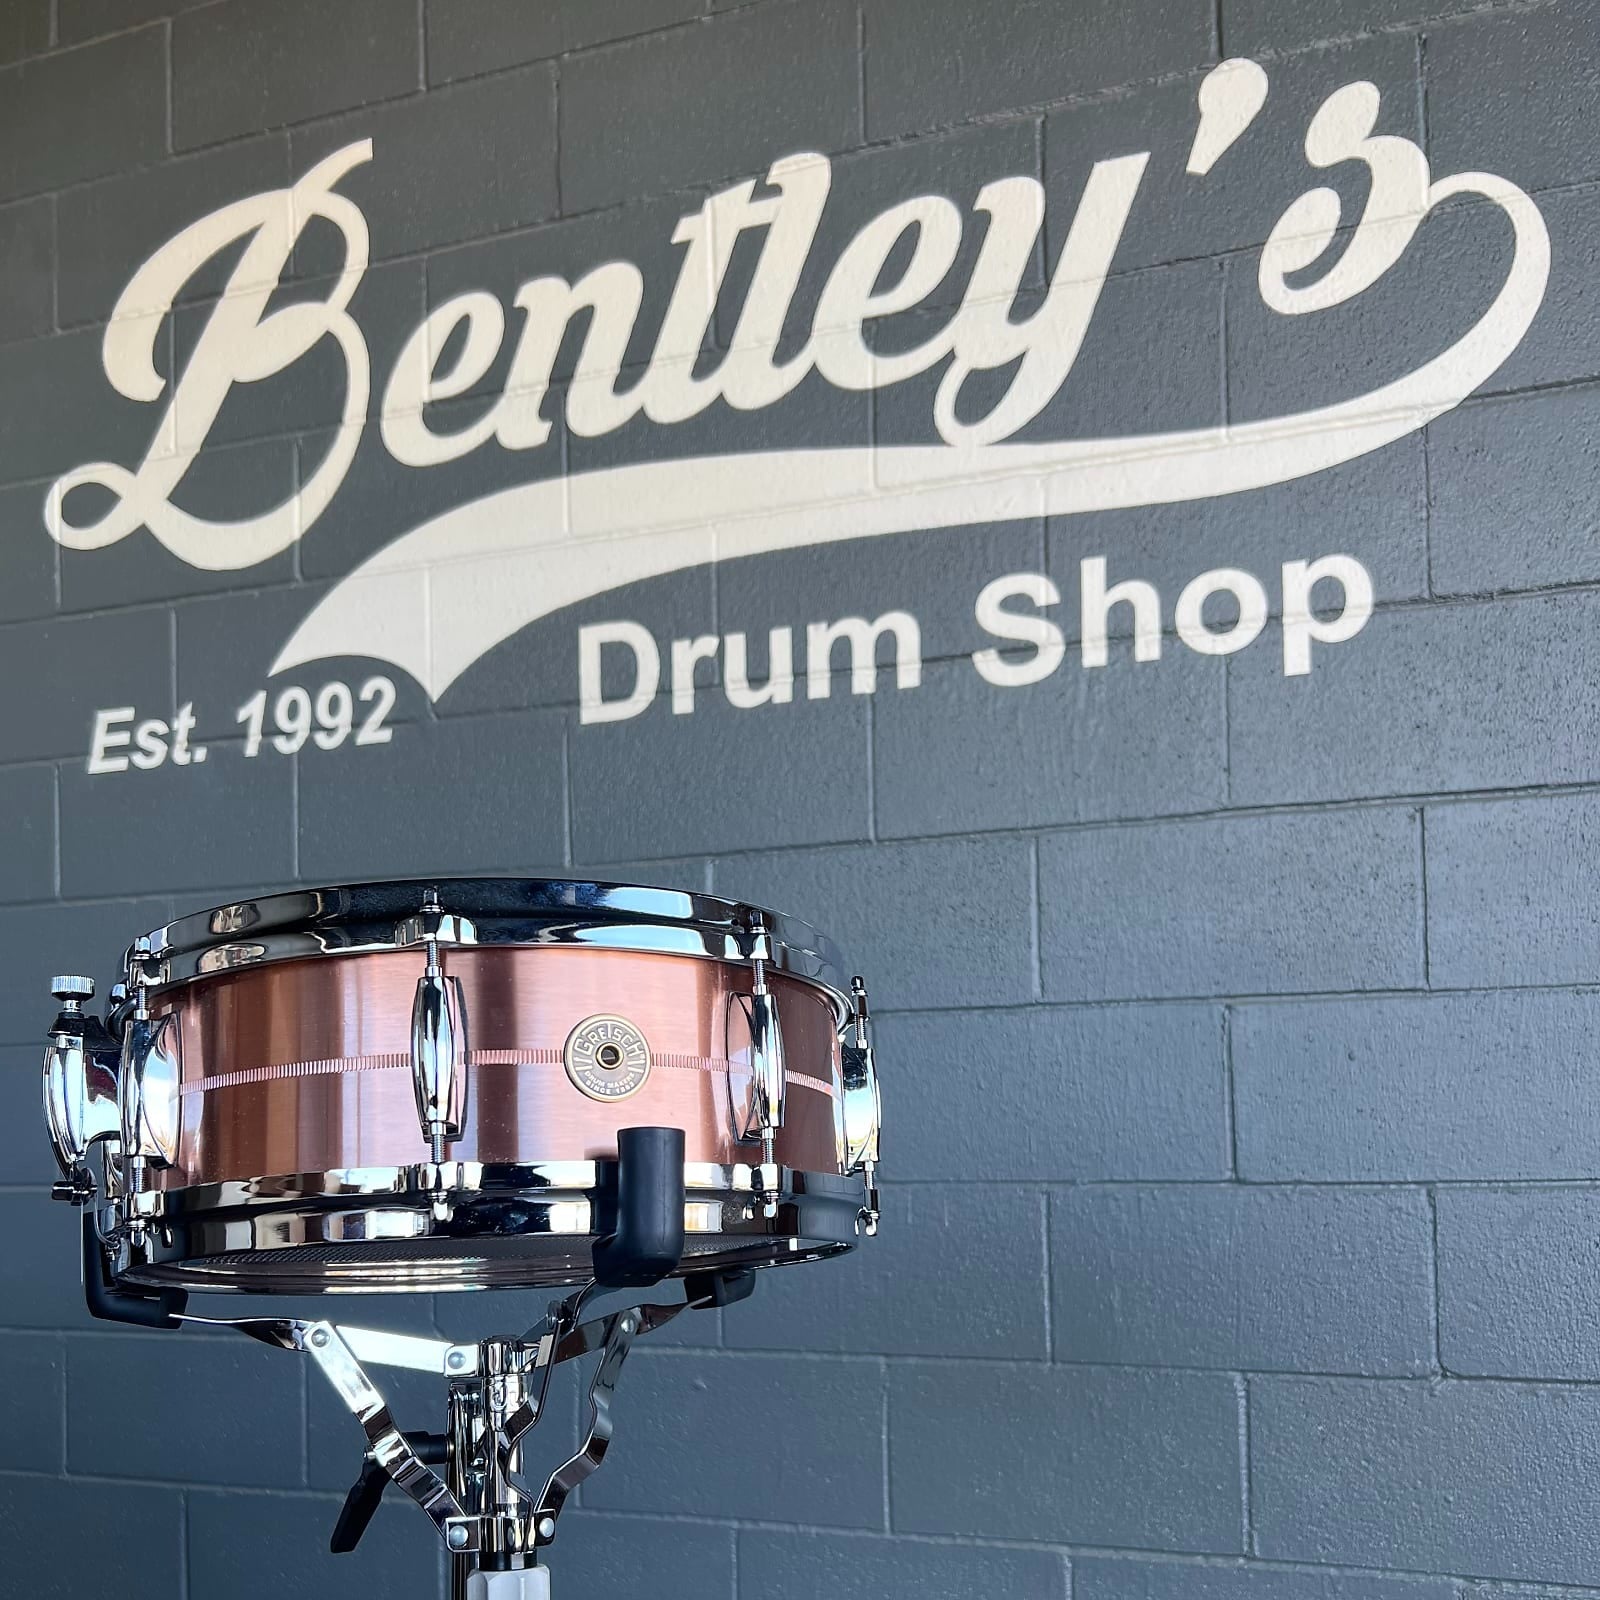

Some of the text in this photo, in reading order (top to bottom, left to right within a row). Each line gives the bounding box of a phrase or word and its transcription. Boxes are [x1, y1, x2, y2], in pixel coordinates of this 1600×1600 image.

[45, 58, 1552, 571] Bentley's
[579, 555, 1377, 726] Drum Shop
[88, 677, 397, 775] Est. 1992
[574, 1021, 645, 1058] GRETSCH
